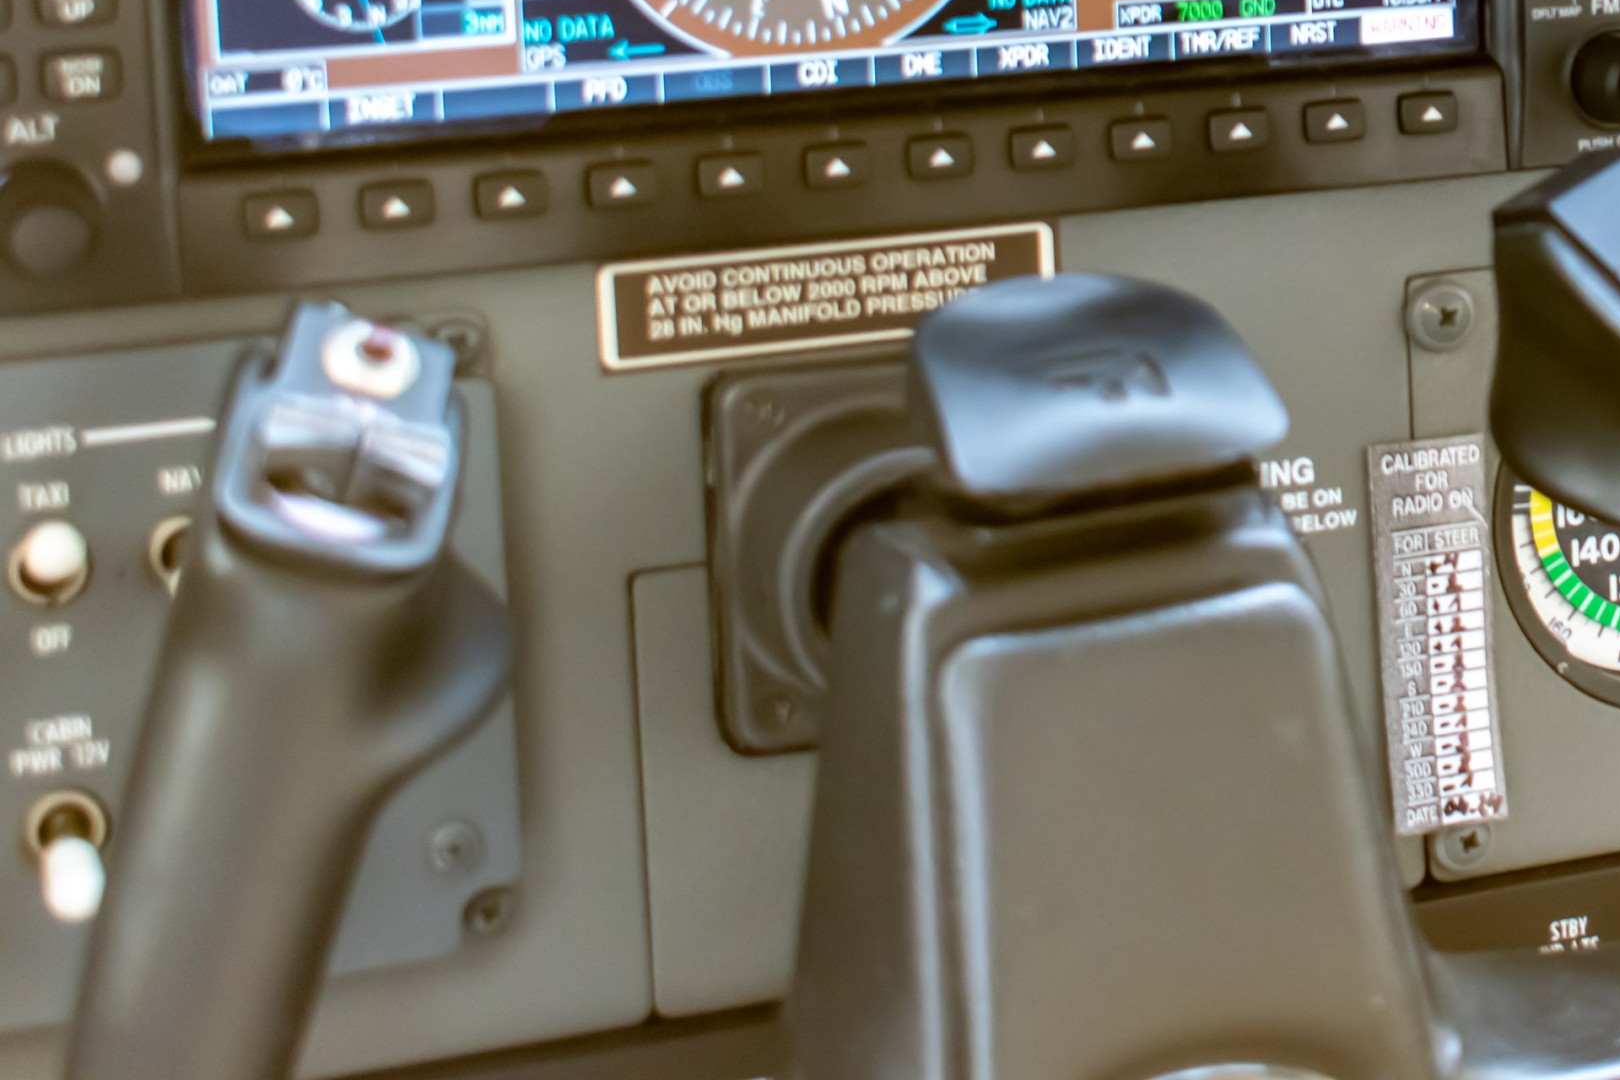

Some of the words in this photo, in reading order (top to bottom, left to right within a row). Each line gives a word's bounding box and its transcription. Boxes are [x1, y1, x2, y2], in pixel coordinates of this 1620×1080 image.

[1176, 0, 1223, 23] 7000
[1093, 35, 1152, 62] IDENT
[649, 272, 717, 300] AVOID
[720, 258, 866, 290] CONTINUOUS
[870, 242, 996, 272] OPERATION
[649, 297, 680, 320] AT
[684, 292, 717, 314] OR
[721, 282, 802, 310] BELOW
[862, 272, 909, 297] RPM
[913, 262, 989, 289] ABOVE
[680, 315, 709, 336] IN.
[714, 311, 743, 336] Hg
[748, 299, 862, 330] MANIFOLD
[1381, 443, 1480, 476] CALIBRATED
[1414, 471, 1449, 491] FOR
[1281, 490, 1309, 512] BE
[1313, 487, 1343, 507] ON
[1392, 493, 1444, 518] RADIO
[1448, 488, 1474, 508] ON
[1394, 533, 1423, 553] FOR
[1433, 526, 1478, 549] STEER
[1571, 532, 1620, 568] 140
[1406, 806, 1440, 827] DATE
[1550, 917, 1589, 941] STBY
